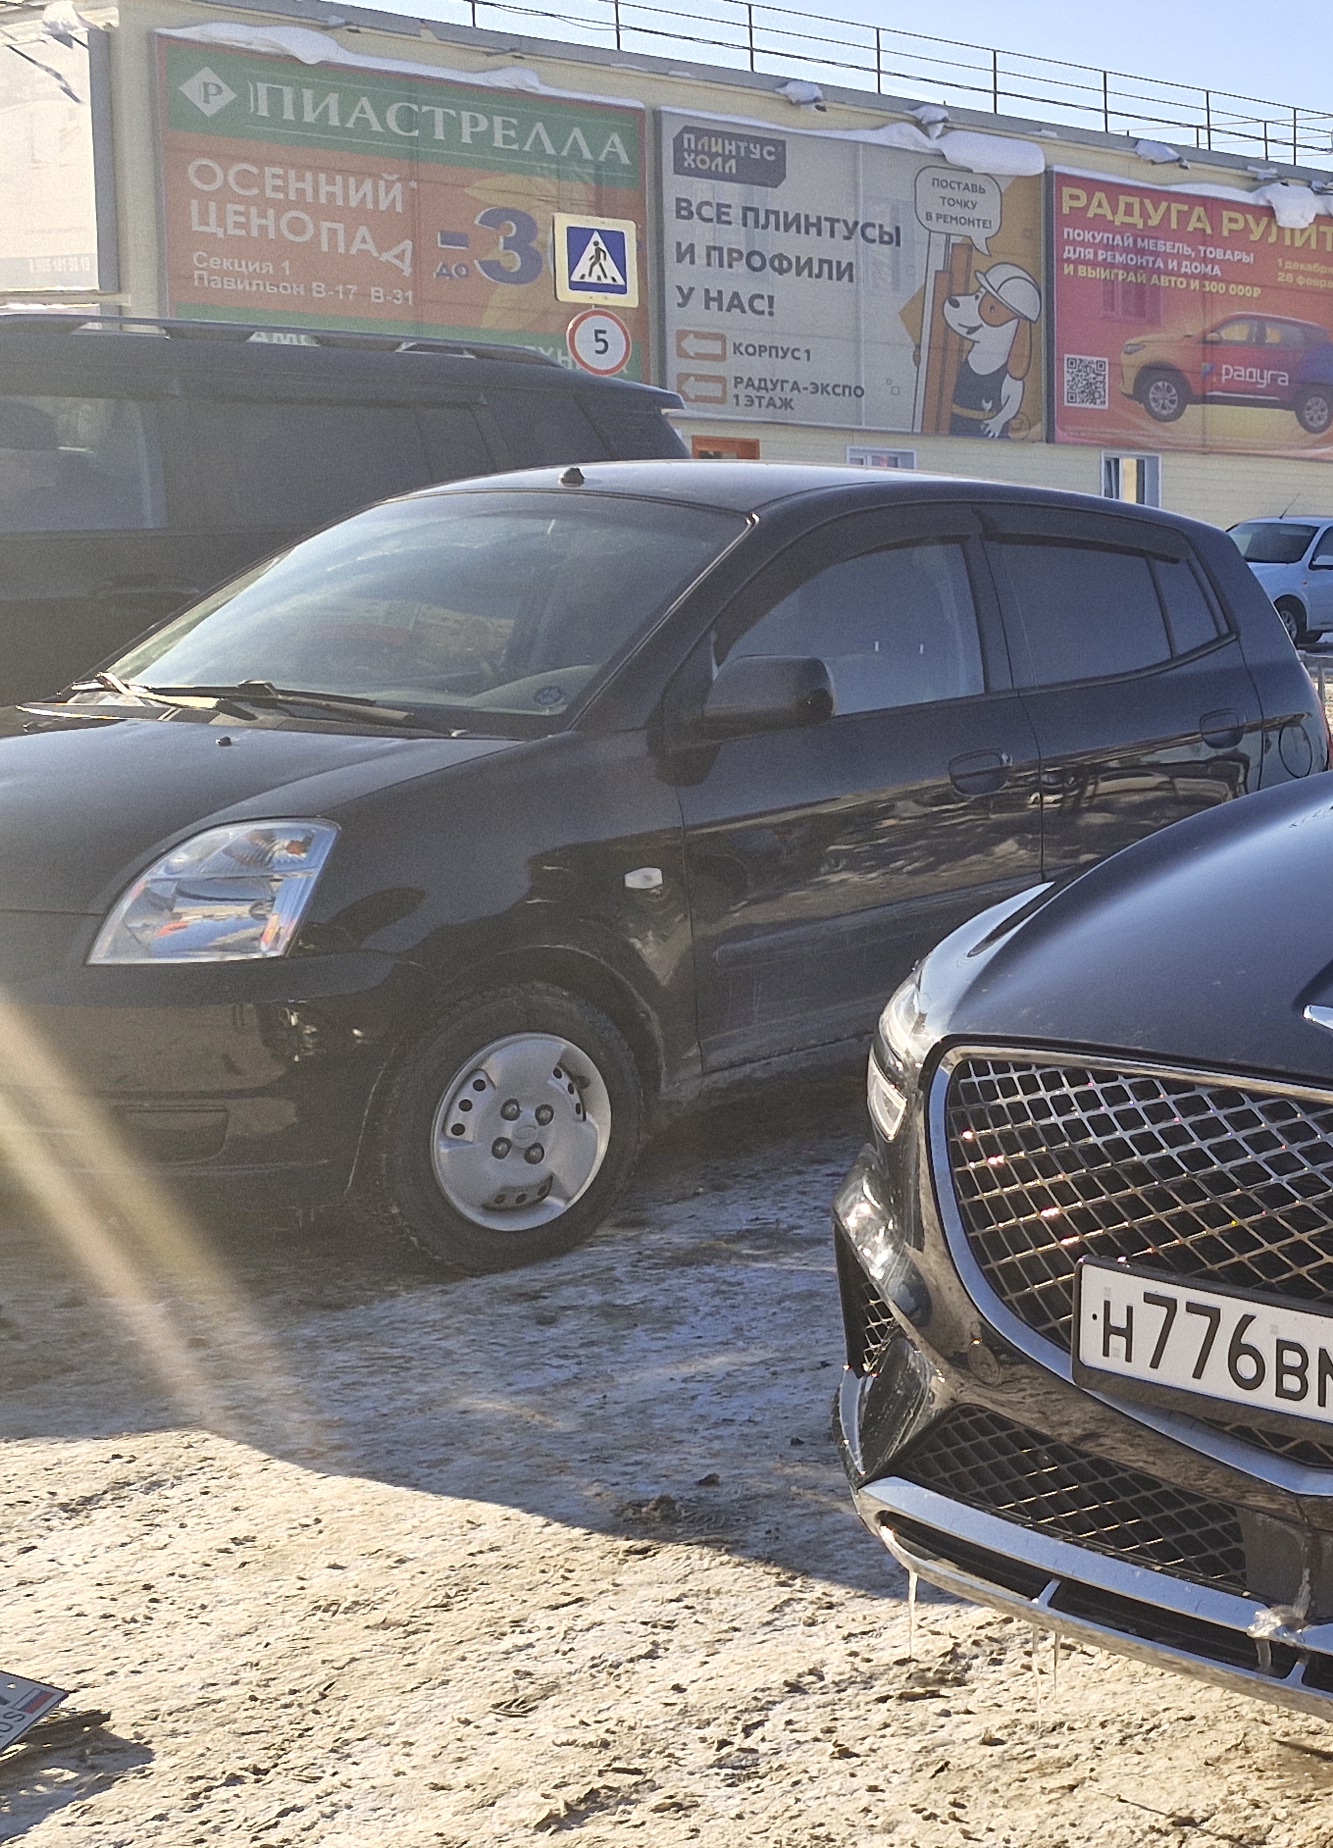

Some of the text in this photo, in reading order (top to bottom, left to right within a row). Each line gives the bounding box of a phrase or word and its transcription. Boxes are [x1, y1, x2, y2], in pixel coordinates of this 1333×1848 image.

[248, 80, 633, 166] ПИАСТРЕЛЛА
[683, 132, 777, 161] ПЛИНТУС
[683, 151, 737, 175] ХОЛЛ
[931, 177, 987, 195] ПОСТАВЬ
[939, 195, 978, 211] ТОЧКУ
[1061, 186, 1213, 235] РАДУГА
[674, 196, 902, 248] ВСЕ ПЛИНТУСЫ
[925, 211, 993, 230] В РЕМОНТЕ!
[189, 199, 415, 278] ЦЕНОПАД
[1063, 227, 1255, 265] ПОКУПАЙ МЕБЕЛЬ, ТОВАРЫ
[192, 250, 291, 276] Секция 1
[675, 241, 855, 284] И ПРОФИЛИ
[1063, 245, 1222, 277] ДЛЯ РЕМОНТА И ДОМА
[1277, 257, 1284, 268] 1
[193, 269, 415, 306] Павильон В-17 В-31
[1063, 263, 1075, 275] И
[1077, 265, 1147, 285] ВЫИГРАЙ
[1151, 274, 1187, 290] АВТО
[1190, 279, 1201, 291] И
[1203, 280, 1226, 295] 300
[675, 284, 776, 318] У НАС!
[593, 328, 609, 355] 5
[732, 342, 812, 362] КОРПУС 1
[733, 375, 866, 399] РАДУГА-ЭКСПО
[1221, 363, 1290, 389] радуга
[733, 393, 795, 412] 1 ЭТАЖ
